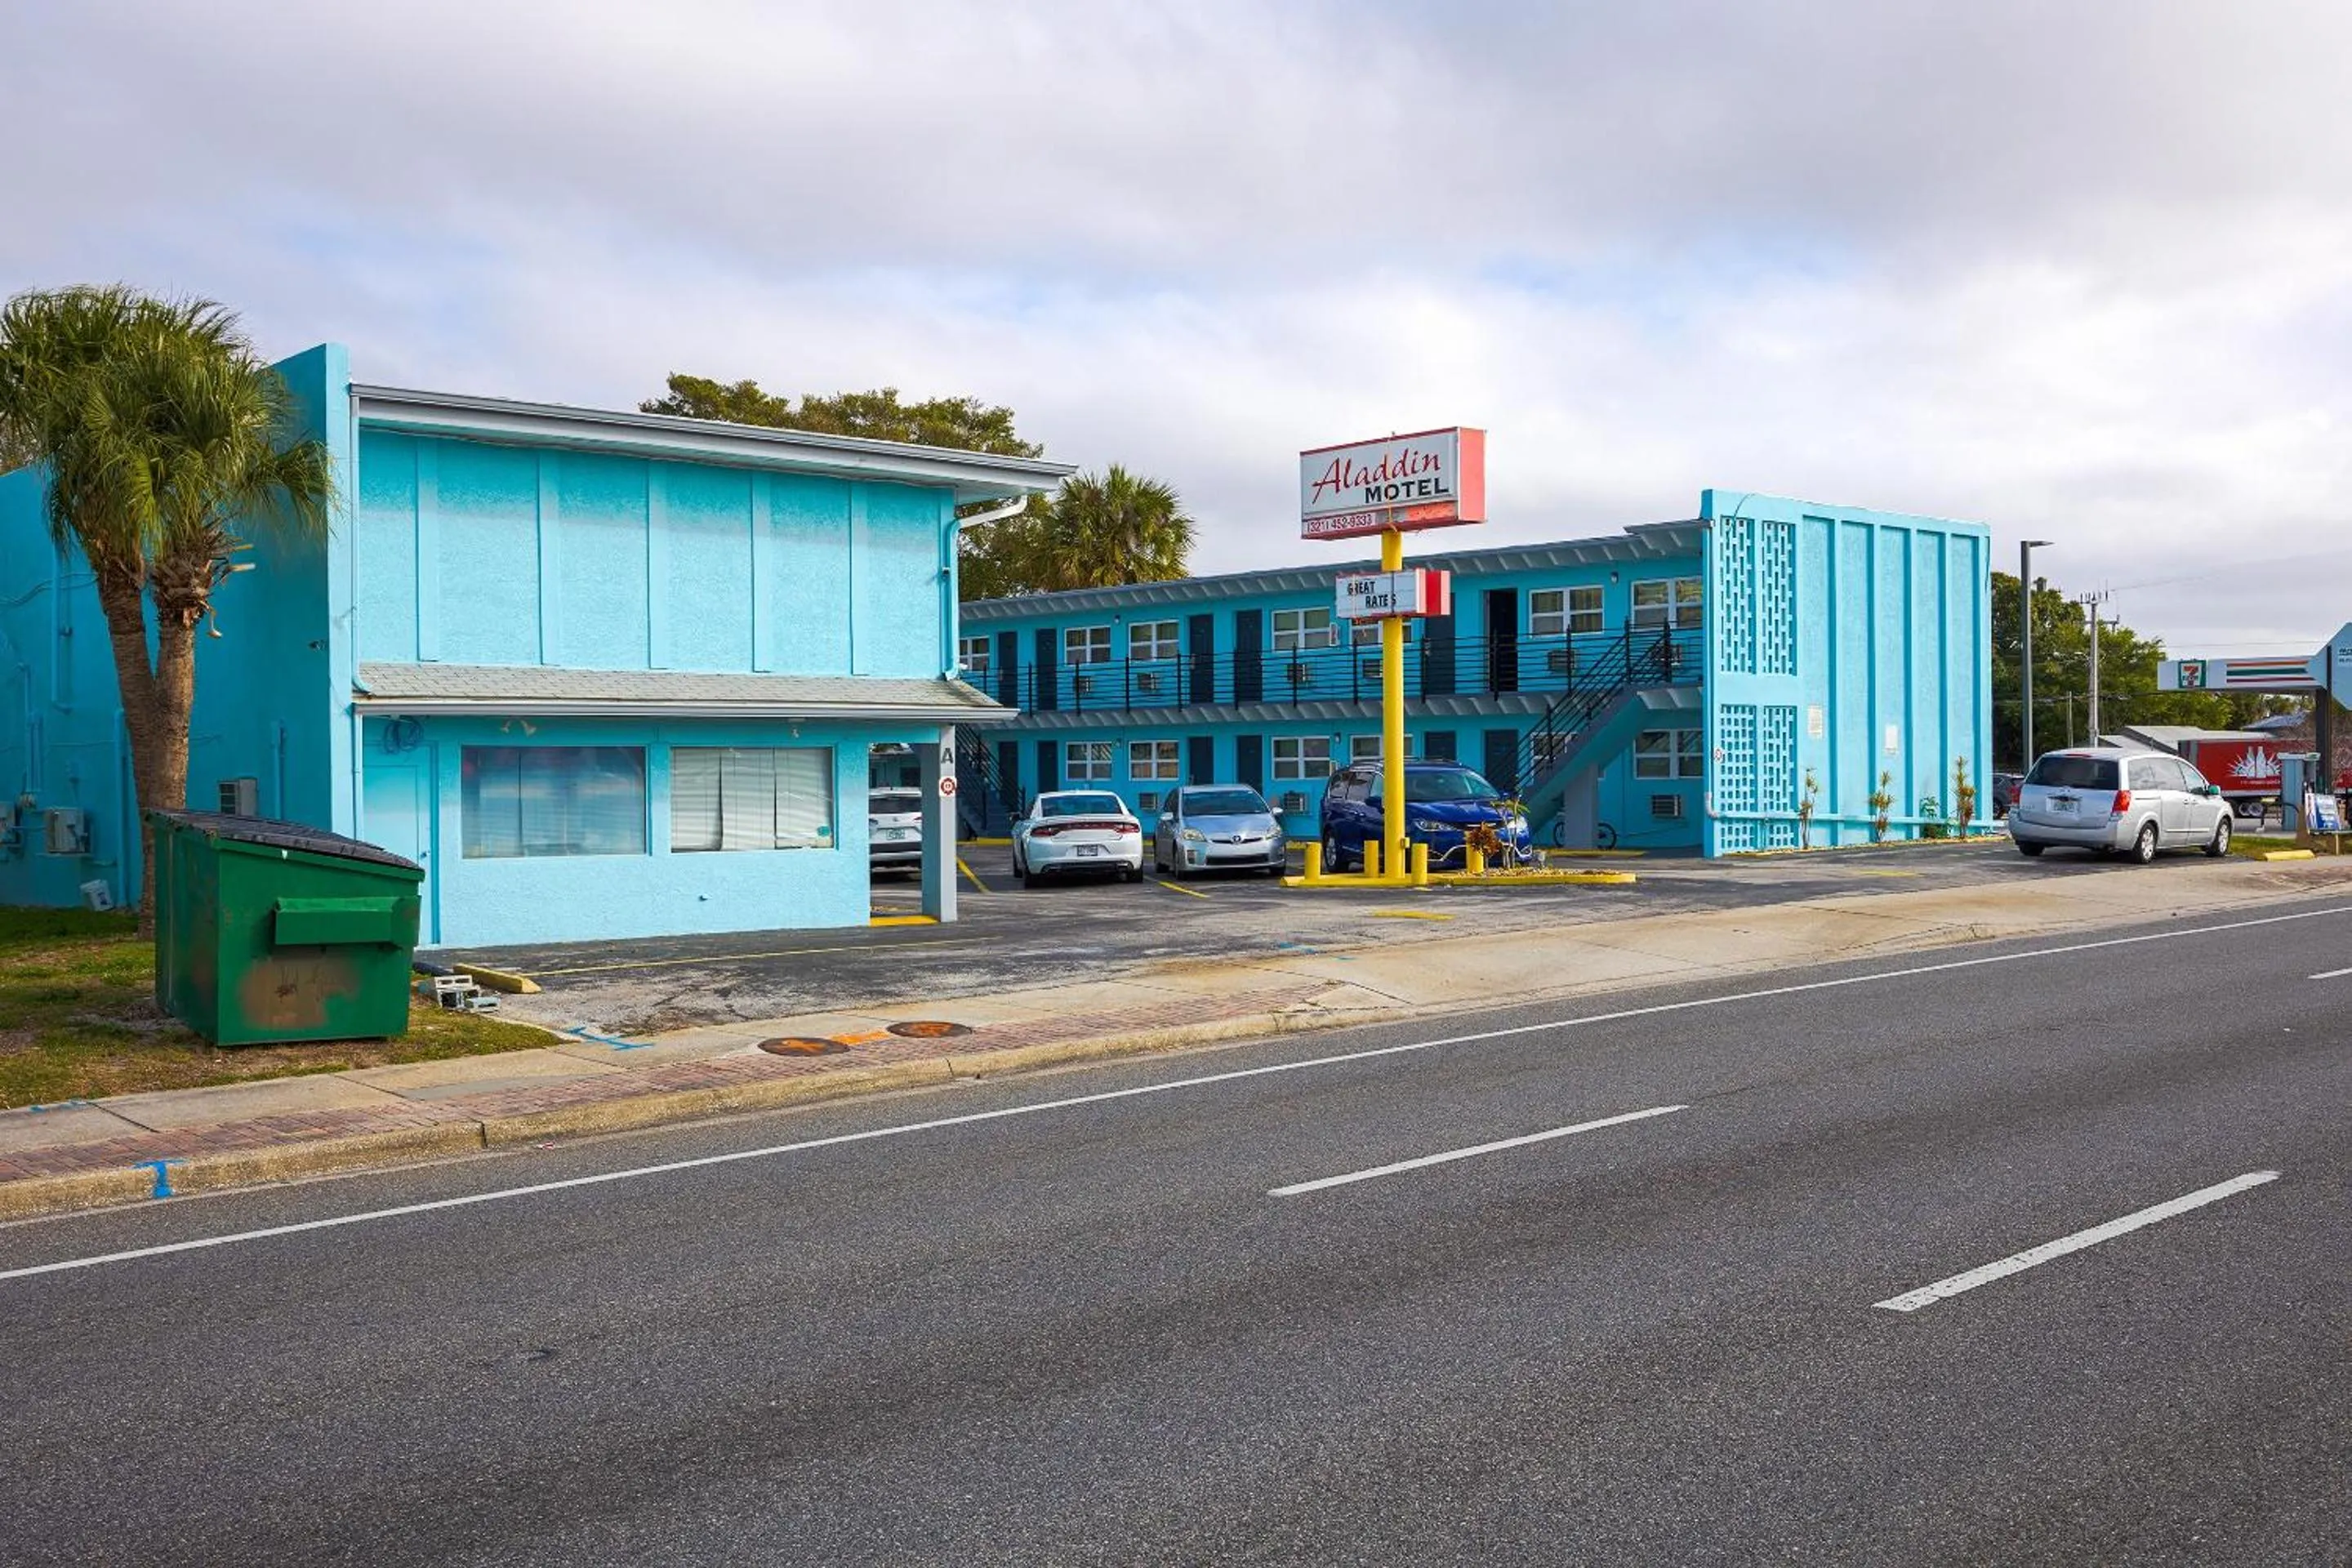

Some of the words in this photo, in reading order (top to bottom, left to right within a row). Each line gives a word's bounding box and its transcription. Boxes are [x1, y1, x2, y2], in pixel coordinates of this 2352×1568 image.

[1312, 448, 1441, 505] Aladdin
[1365, 478, 1450, 504] MOTEL
[1348, 581, 1375, 595] GREAT
[941, 747, 954, 764] A
